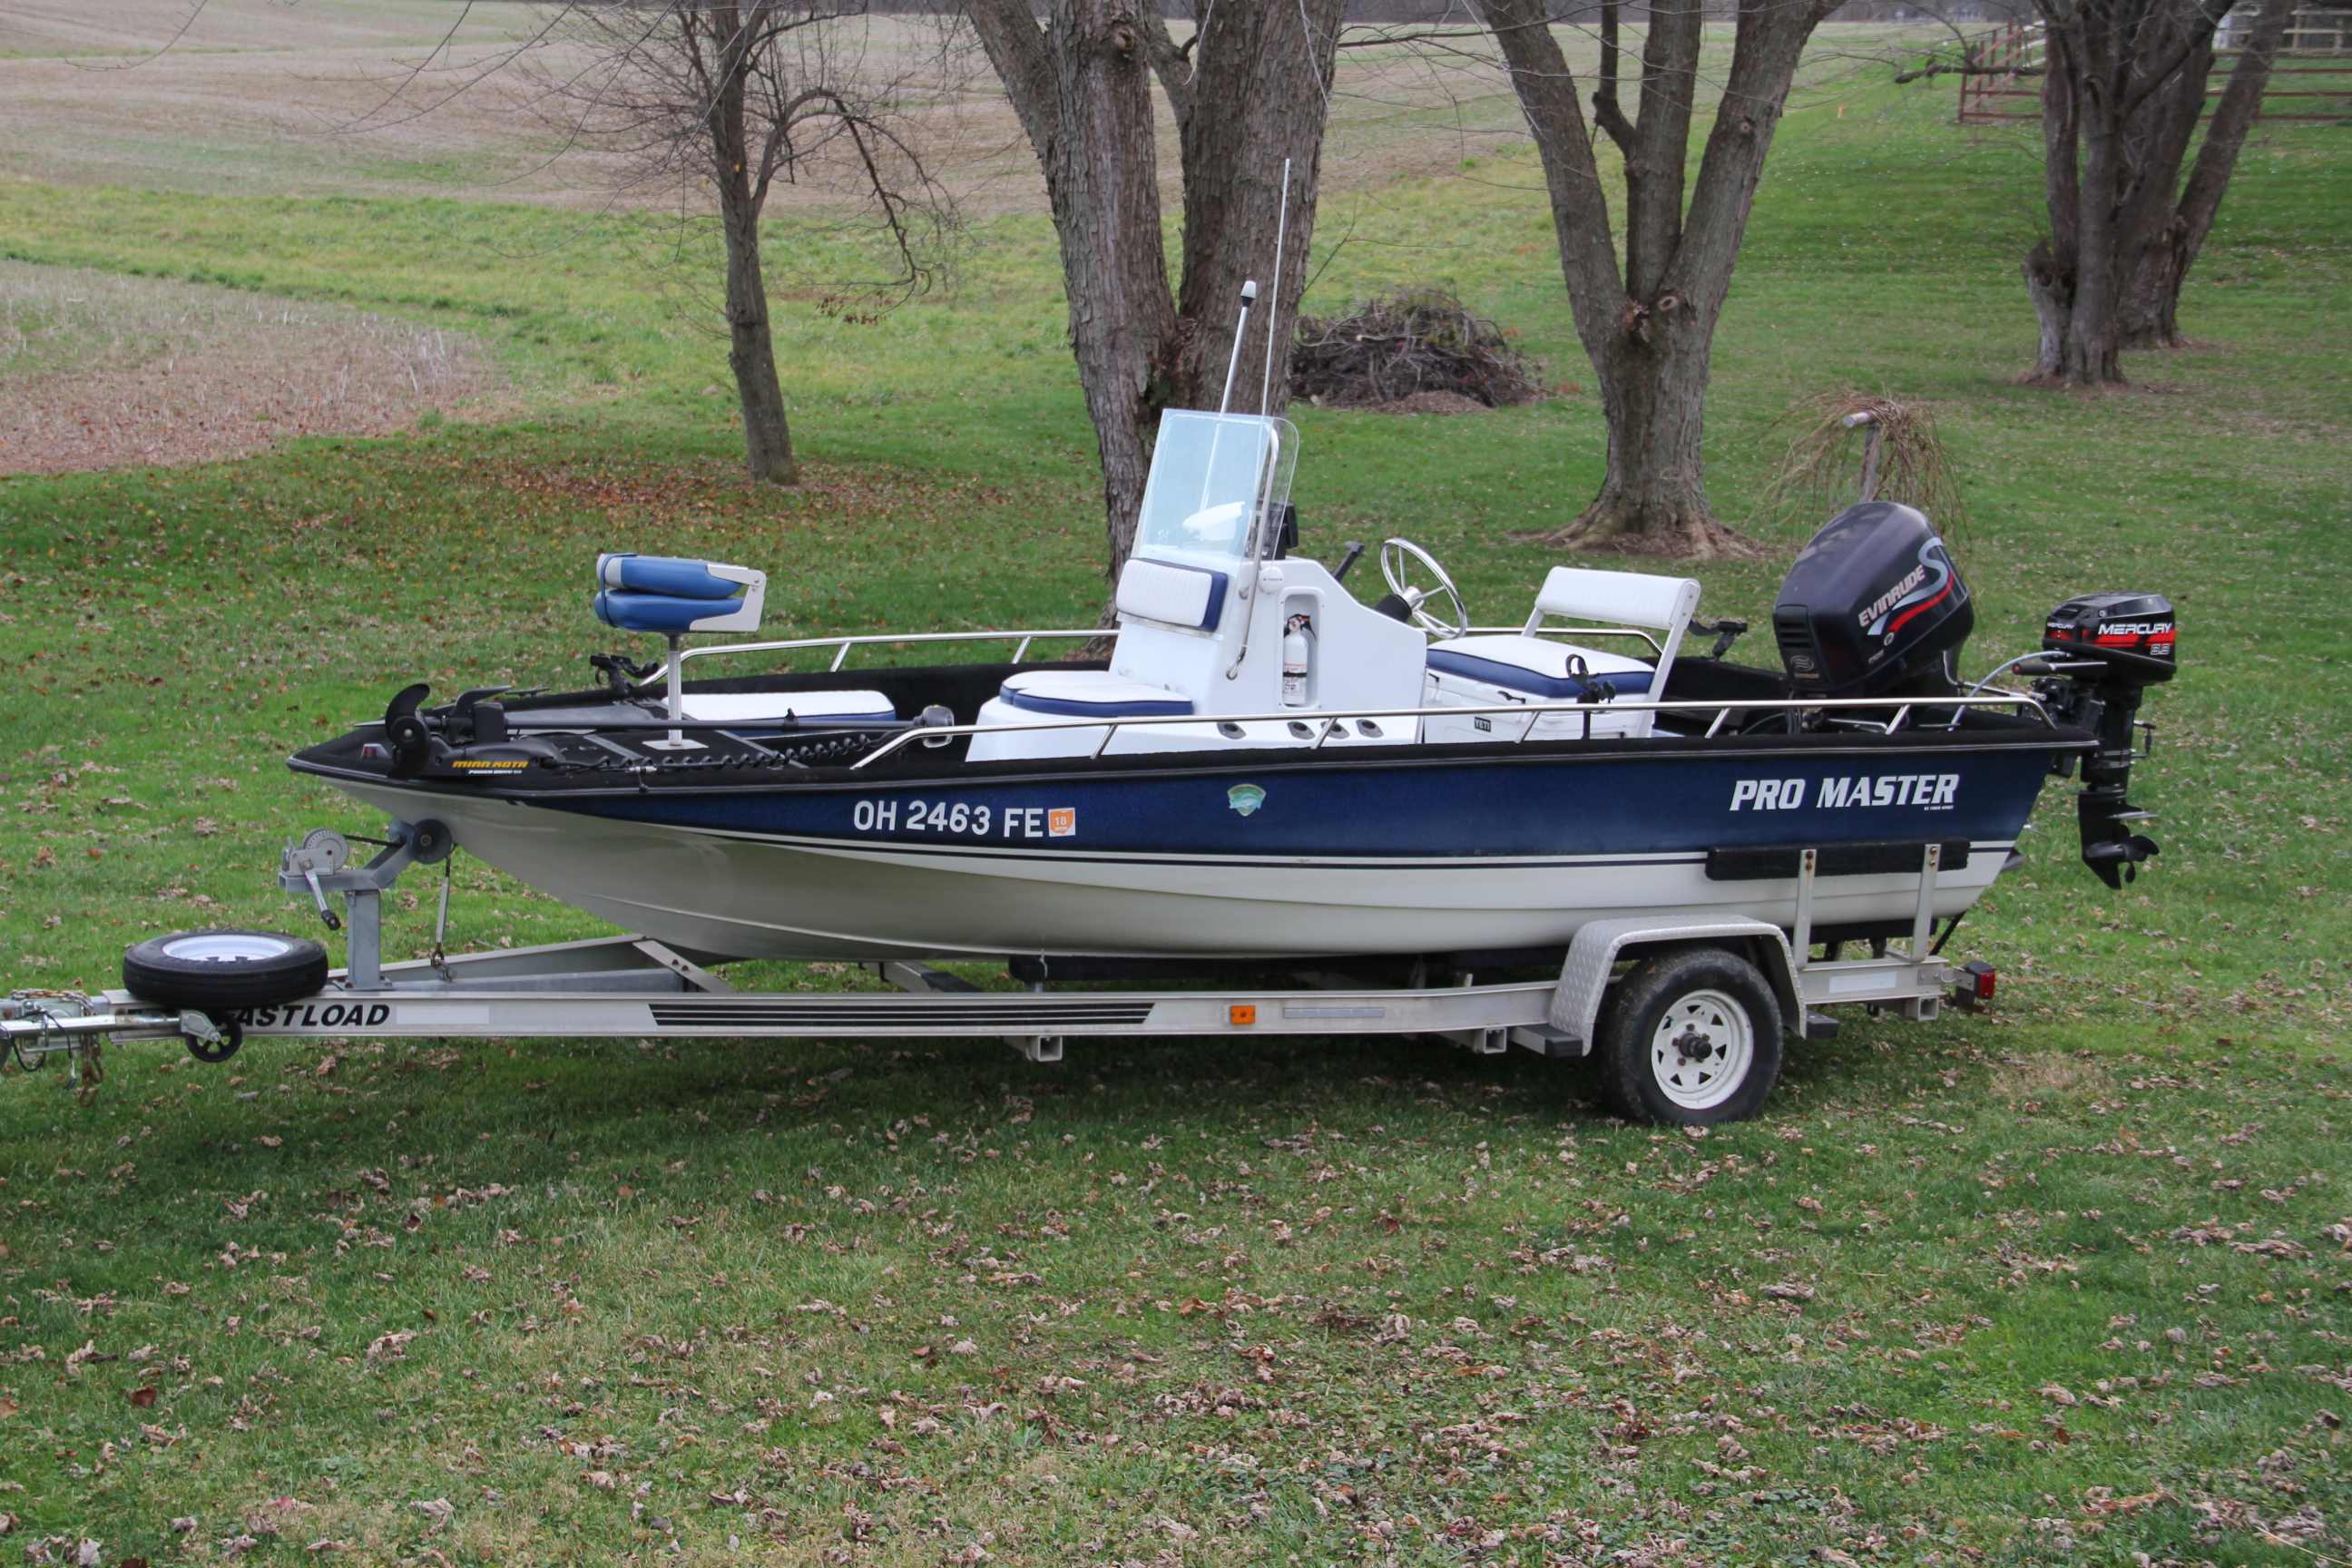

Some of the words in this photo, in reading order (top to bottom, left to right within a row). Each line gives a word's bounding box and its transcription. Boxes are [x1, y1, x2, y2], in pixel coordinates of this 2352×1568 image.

[1858, 564, 1926, 627] EVINRUDE
[2098, 622, 2172, 634] MERCURY
[2150, 643, 2170, 655] 9.9
[1475, 718, 1491, 730] YETI
[1729, 779, 1806, 811] PRO
[1816, 774, 1959, 808] MASTER
[854, 800, 897, 831] OH
[906, 800, 991, 836] 2463
[1004, 808, 1044, 838] FE
[1054, 817, 1067, 826] 18
[227, 1004, 389, 1026] ASTLOAD
